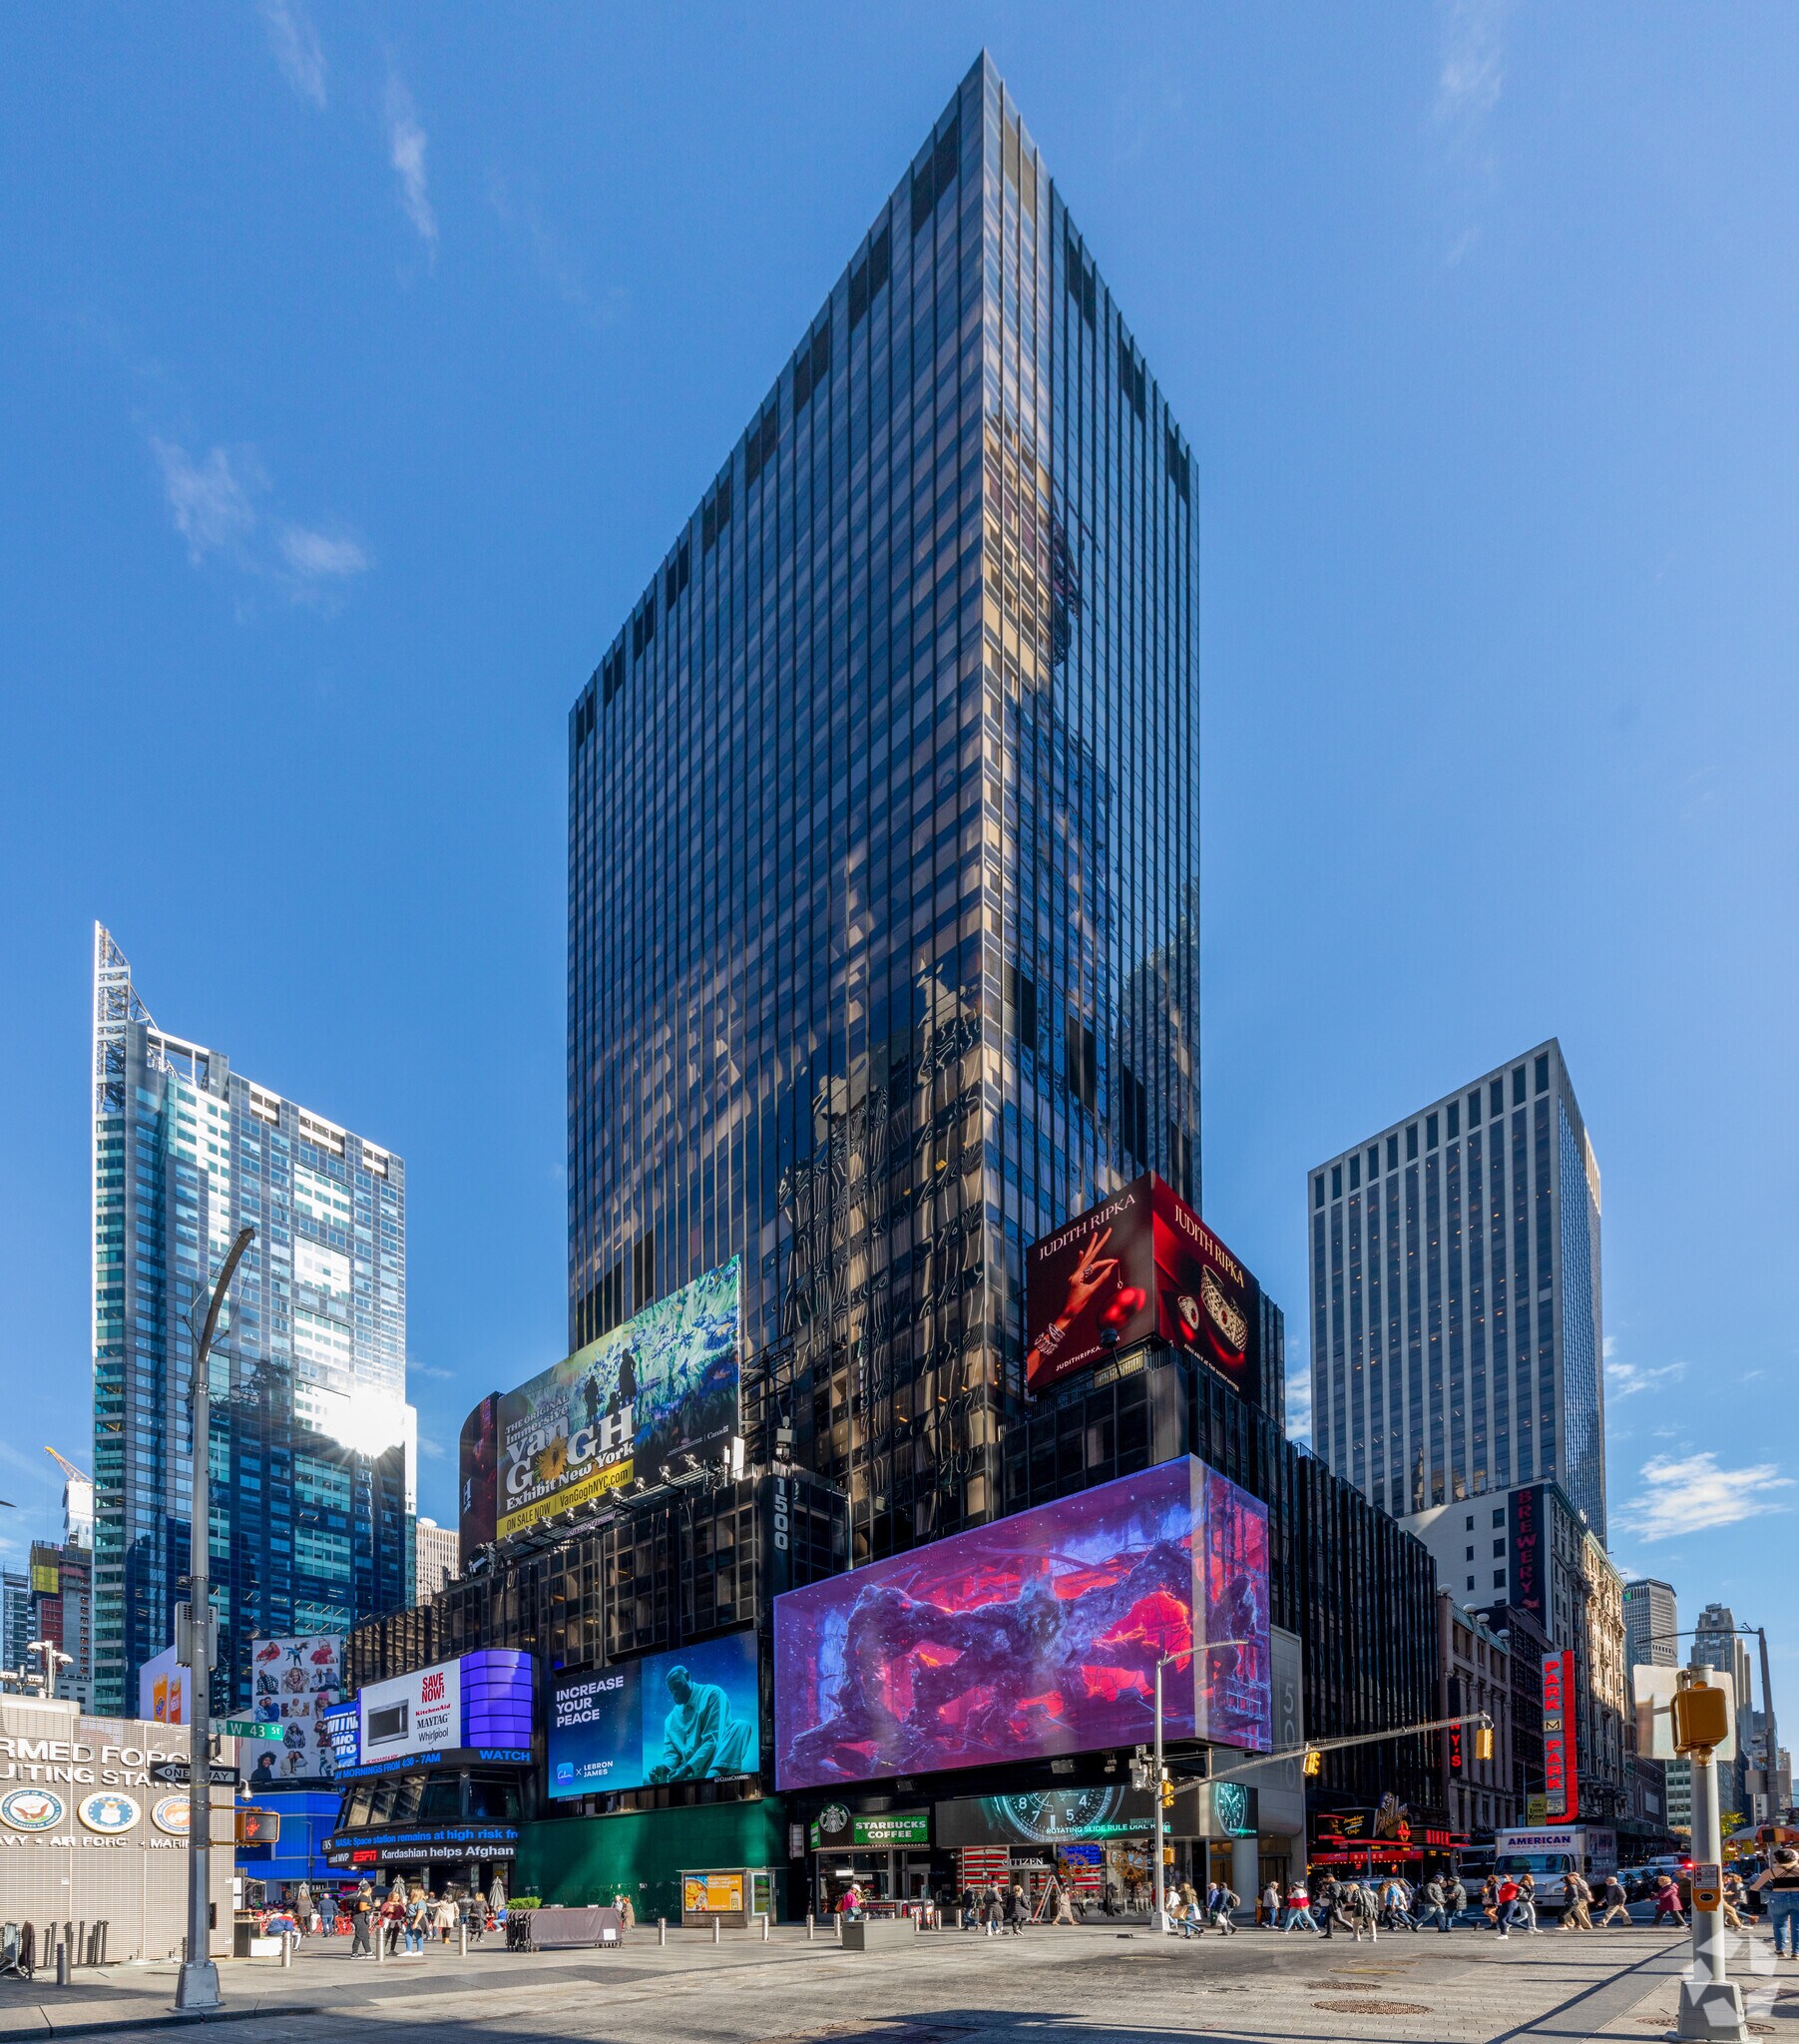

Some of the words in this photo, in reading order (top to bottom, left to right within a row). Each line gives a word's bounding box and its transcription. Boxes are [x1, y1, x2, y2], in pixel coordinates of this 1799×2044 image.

[1039, 1223, 1087, 1261] JUDITH
[1091, 1194, 1135, 1230] RIPKA
[1174, 1204, 1213, 1258] JUDITH
[1214, 1244, 1244, 1288] RIPKA
[506, 1417, 523, 1434] THE
[524, 1395, 569, 1423] ORIGINAL
[506, 1404, 569, 1445] Immersive
[706, 1424, 729, 1440] Canada
[506, 1479, 556, 1512] Exhibit
[559, 1462, 594, 1487] New
[595, 1442, 635, 1469] York
[506, 1518, 516, 1531] ON
[517, 1510, 534, 1527] SALE
[534, 1502, 551, 1521] NOW
[559, 1467, 629, 1508] VanGoghNYC.com
[774, 1477, 788, 1551] 1500
[1517, 1489, 1537, 1594] BREWERY
[422, 1672, 444, 1691] SAVE
[556, 1675, 625, 1703] INCREASE
[1544, 1661, 1561, 1711] PARK
[421, 1685, 445, 1704] NOW!
[415, 1703, 451, 1717] KitchenAid
[556, 1697, 593, 1715] YOUR
[416, 1713, 449, 1730] MAYTAG
[556, 1708, 601, 1728] PEACE
[230, 1724, 242, 1735] W
[249, 1726, 265, 1737] 43
[270, 1726, 280, 1735] St
[418, 1727, 449, 1745] Whirlpool
[164, 1768, 190, 1779] ONE
[343, 1765, 383, 1779] MORNINGS
[383, 1761, 400, 1774] FROM
[420, 1753, 440, 1765] 7AM
[479, 1750, 531, 1762] WATCH
[583, 1761, 614, 1772] LEBRON
[583, 1768, 609, 1778] JAMES
[1547, 1740, 1564, 1789] PARK
[1018, 1796, 1028, 1809] 8
[1079, 1794, 1088, 1807] 4
[1032, 1810, 1040, 1823] 7
[1066, 1808, 1075, 1821] 5
[855, 1820, 926, 1830] STARBUCKS
[867, 1829, 912, 1838] COFFEE
[49, 1834, 76, 1847] AIR
[334, 1836, 352, 1847] NASA:
[353, 1836, 371, 1847] Space
[373, 1833, 396, 1844] station
[397, 1831, 432, 1842] remains
[433, 1830, 445, 1840] at
[447, 1828, 474, 1843] high
[477, 1828, 502, 1839] risk
[1508, 1835, 1572, 1845] AMERICAN
[338, 1852, 349, 1862] MVP
[352, 1849, 377, 1862] ESPN
[381, 1847, 428, 1860] Kardashian
[429, 1846, 462, 1859] helps
[465, 1845, 514, 1858] Afghan
[1001, 1856, 1044, 1866] CITIZEN
